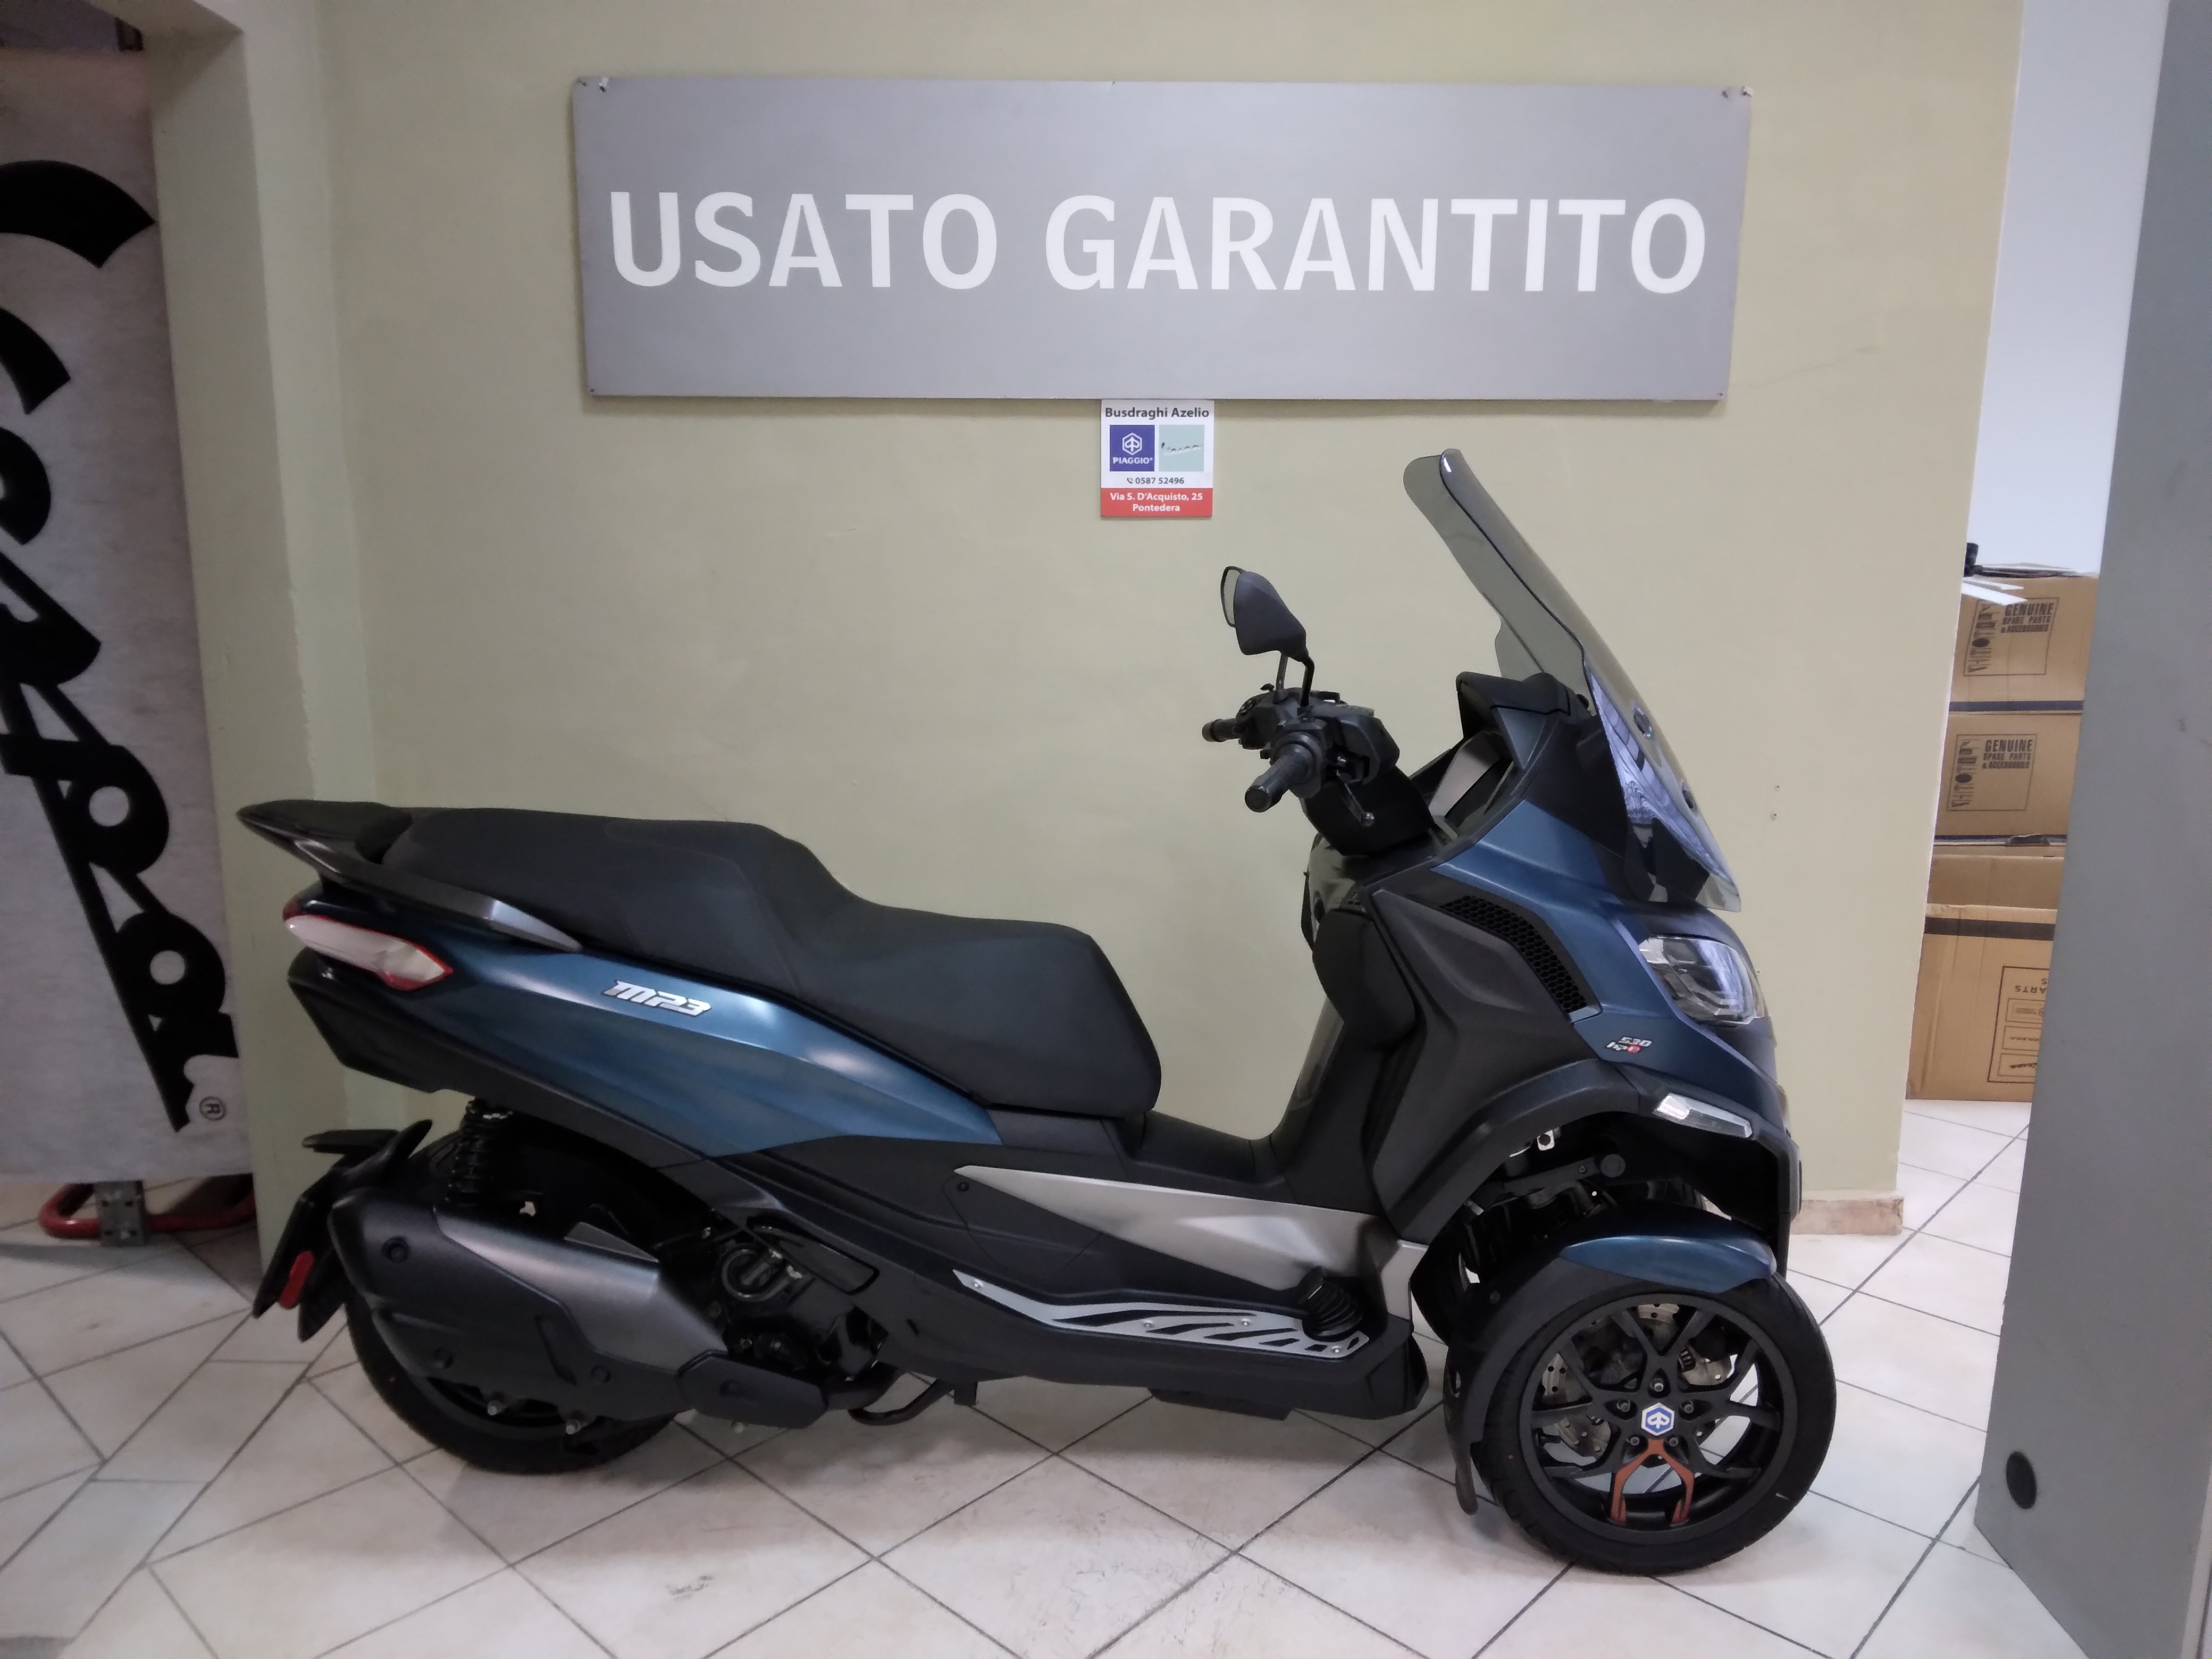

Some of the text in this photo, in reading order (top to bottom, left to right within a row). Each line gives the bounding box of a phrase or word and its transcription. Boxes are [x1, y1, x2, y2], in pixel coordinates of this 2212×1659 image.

[610, 191, 1705, 294] USATO GARANTITO
[1105, 407, 1209, 420] Busdraghi Azelio
[1137, 492, 1189, 502] D'Acquisto,
[2005, 602, 2054, 616] GENUINE
[1985, 739, 2033, 752] GENUINE
[1618, 1036, 1653, 1047] 530
